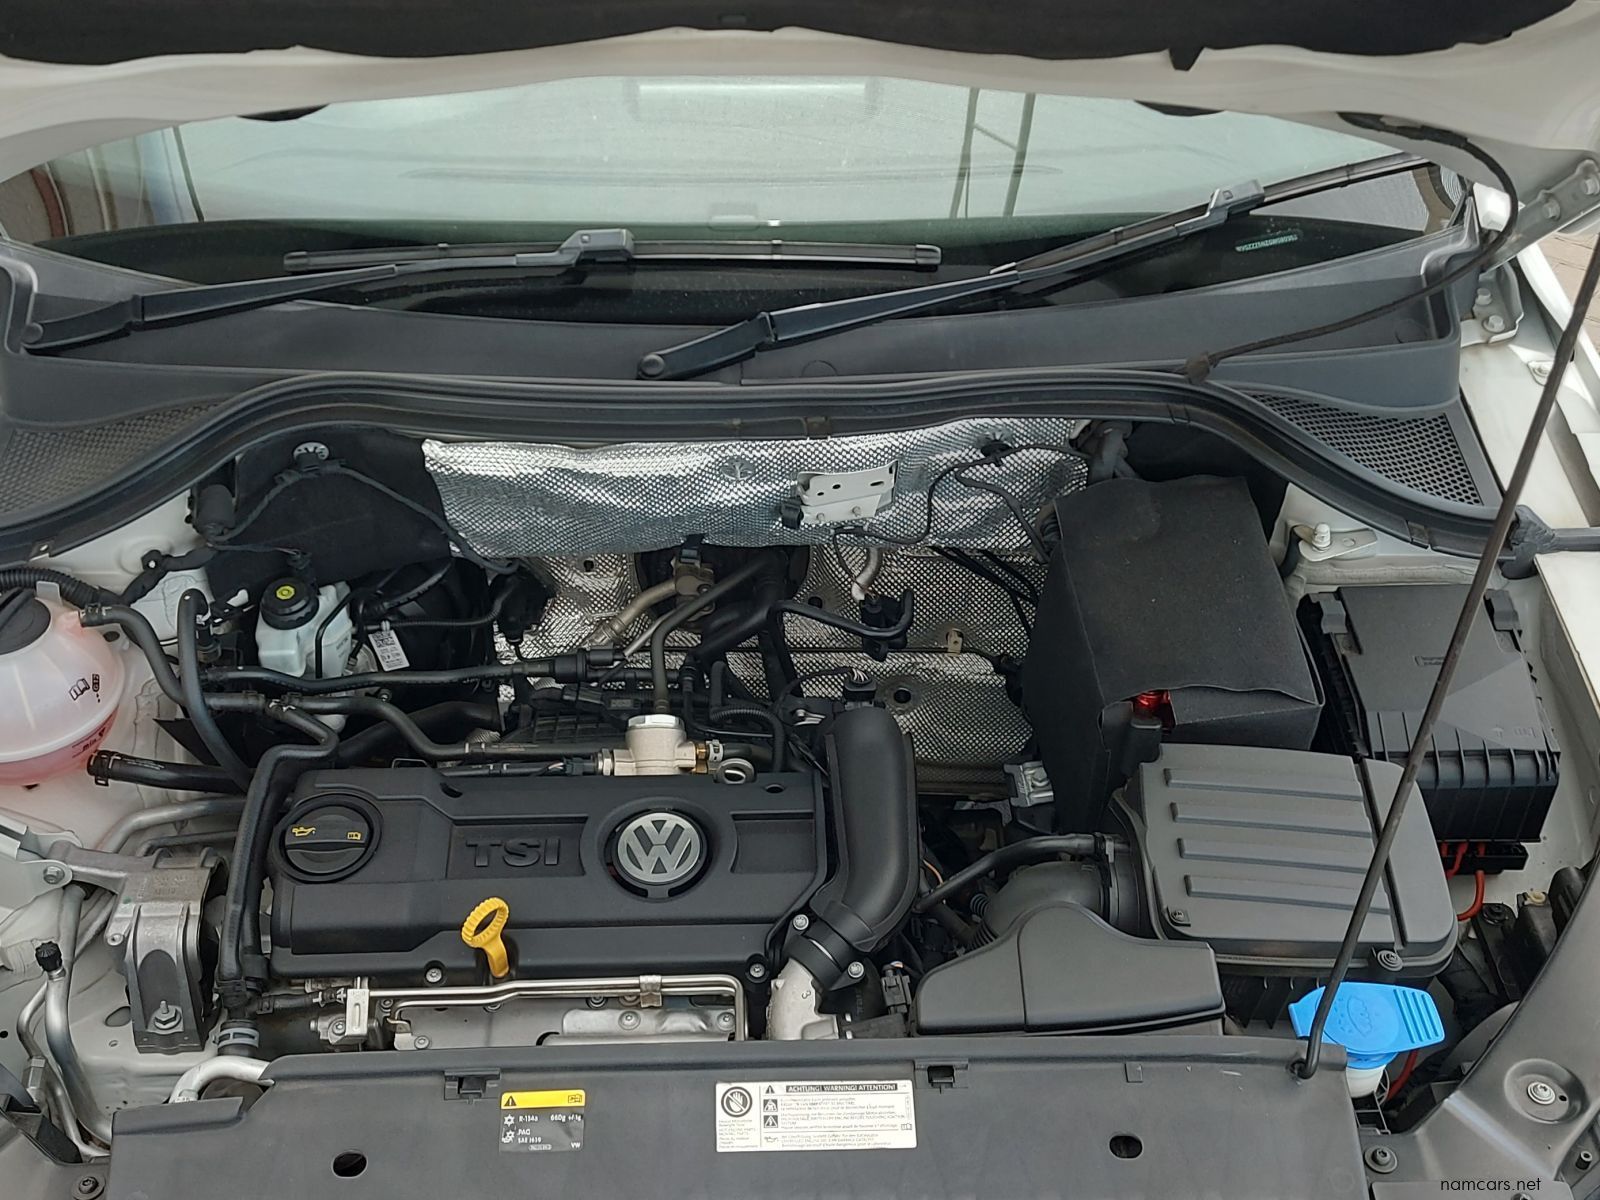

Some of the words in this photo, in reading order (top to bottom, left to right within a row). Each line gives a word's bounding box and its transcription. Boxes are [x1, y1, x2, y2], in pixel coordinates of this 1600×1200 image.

[465, 838, 561, 868] TSI
[617, 812, 701, 883] VW
[787, 1085, 821, 1093] ACHTUNG!
[823, 1084, 858, 1092] WARNING!
[858, 1083, 897, 1092] ATTENTION!
